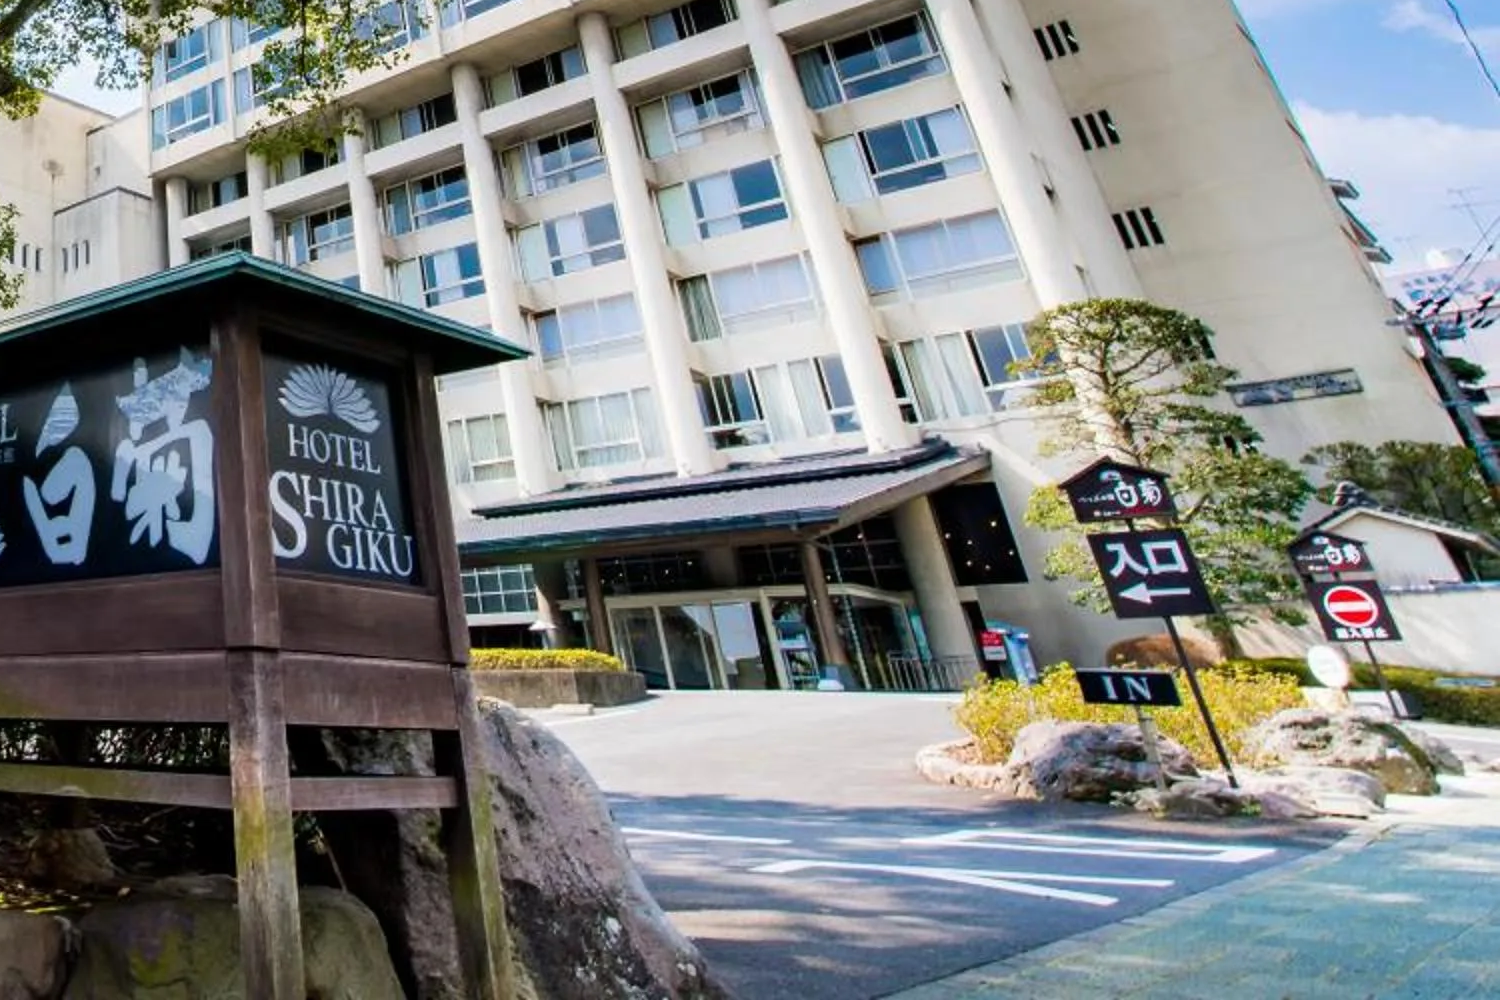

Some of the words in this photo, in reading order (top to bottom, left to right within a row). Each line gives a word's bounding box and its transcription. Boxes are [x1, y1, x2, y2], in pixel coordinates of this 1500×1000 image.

[23, 345, 215, 566] 白菊
[287, 423, 381, 475] HOTEL
[268, 469, 395, 560] SHIRA
[1113, 478, 1163, 508] 白菊
[325, 523, 414, 577] GIKU
[1106, 538, 1190, 579] 入口
[1101, 675, 1153, 701] IN
